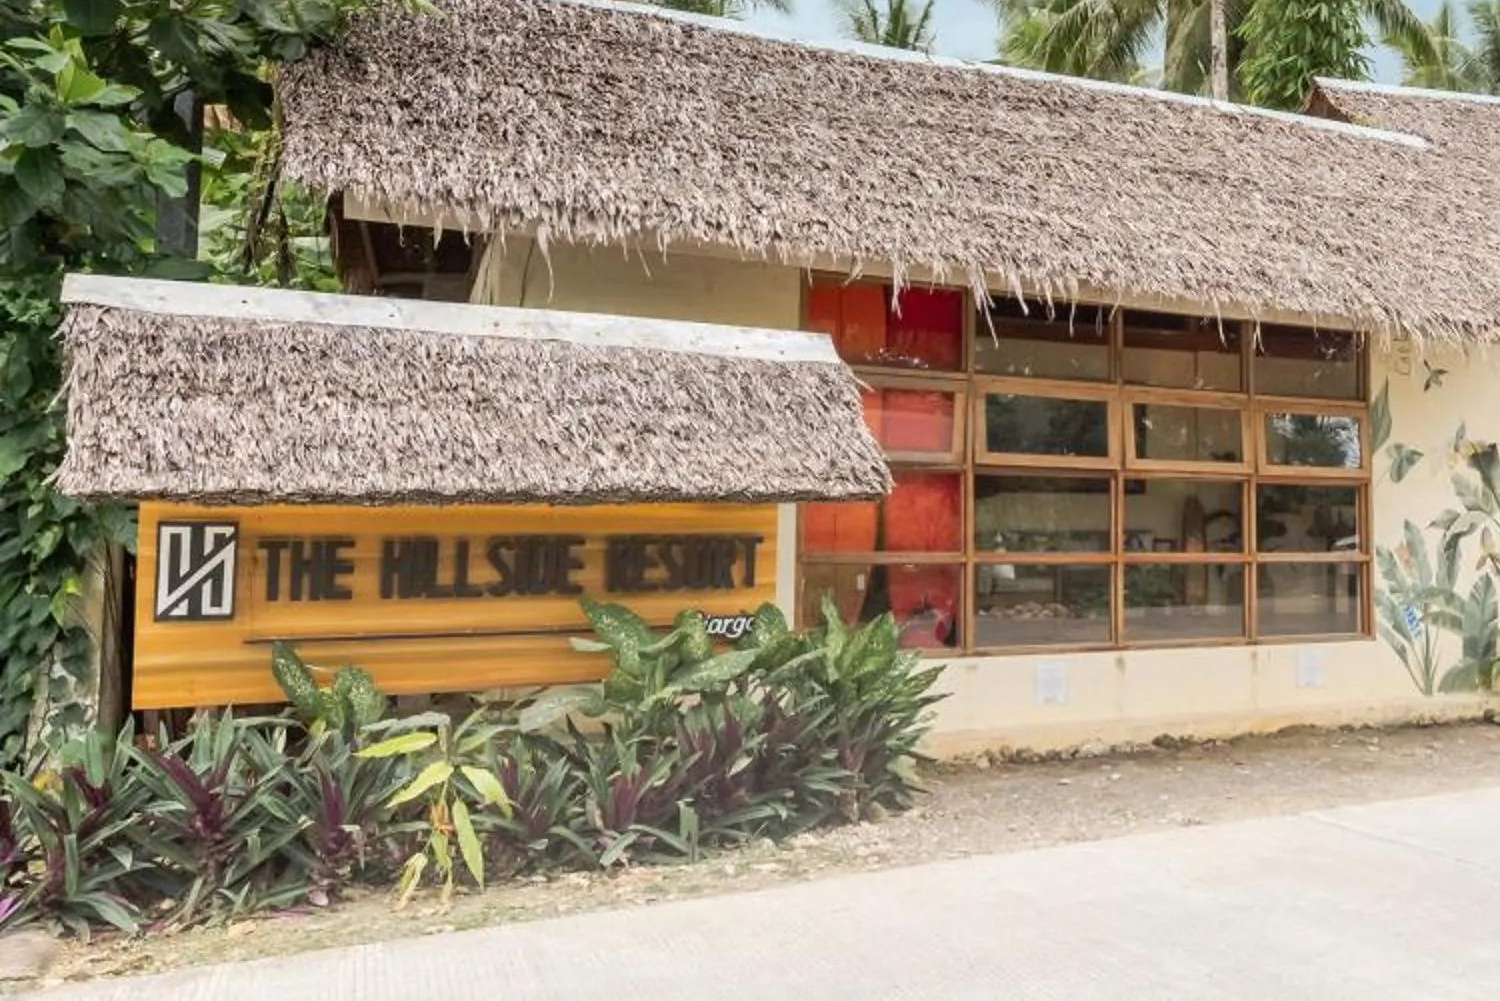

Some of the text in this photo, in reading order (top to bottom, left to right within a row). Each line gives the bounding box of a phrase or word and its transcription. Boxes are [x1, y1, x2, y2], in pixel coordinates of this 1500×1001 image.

[257, 534, 764, 601] THE HILLSIDE RESORT
